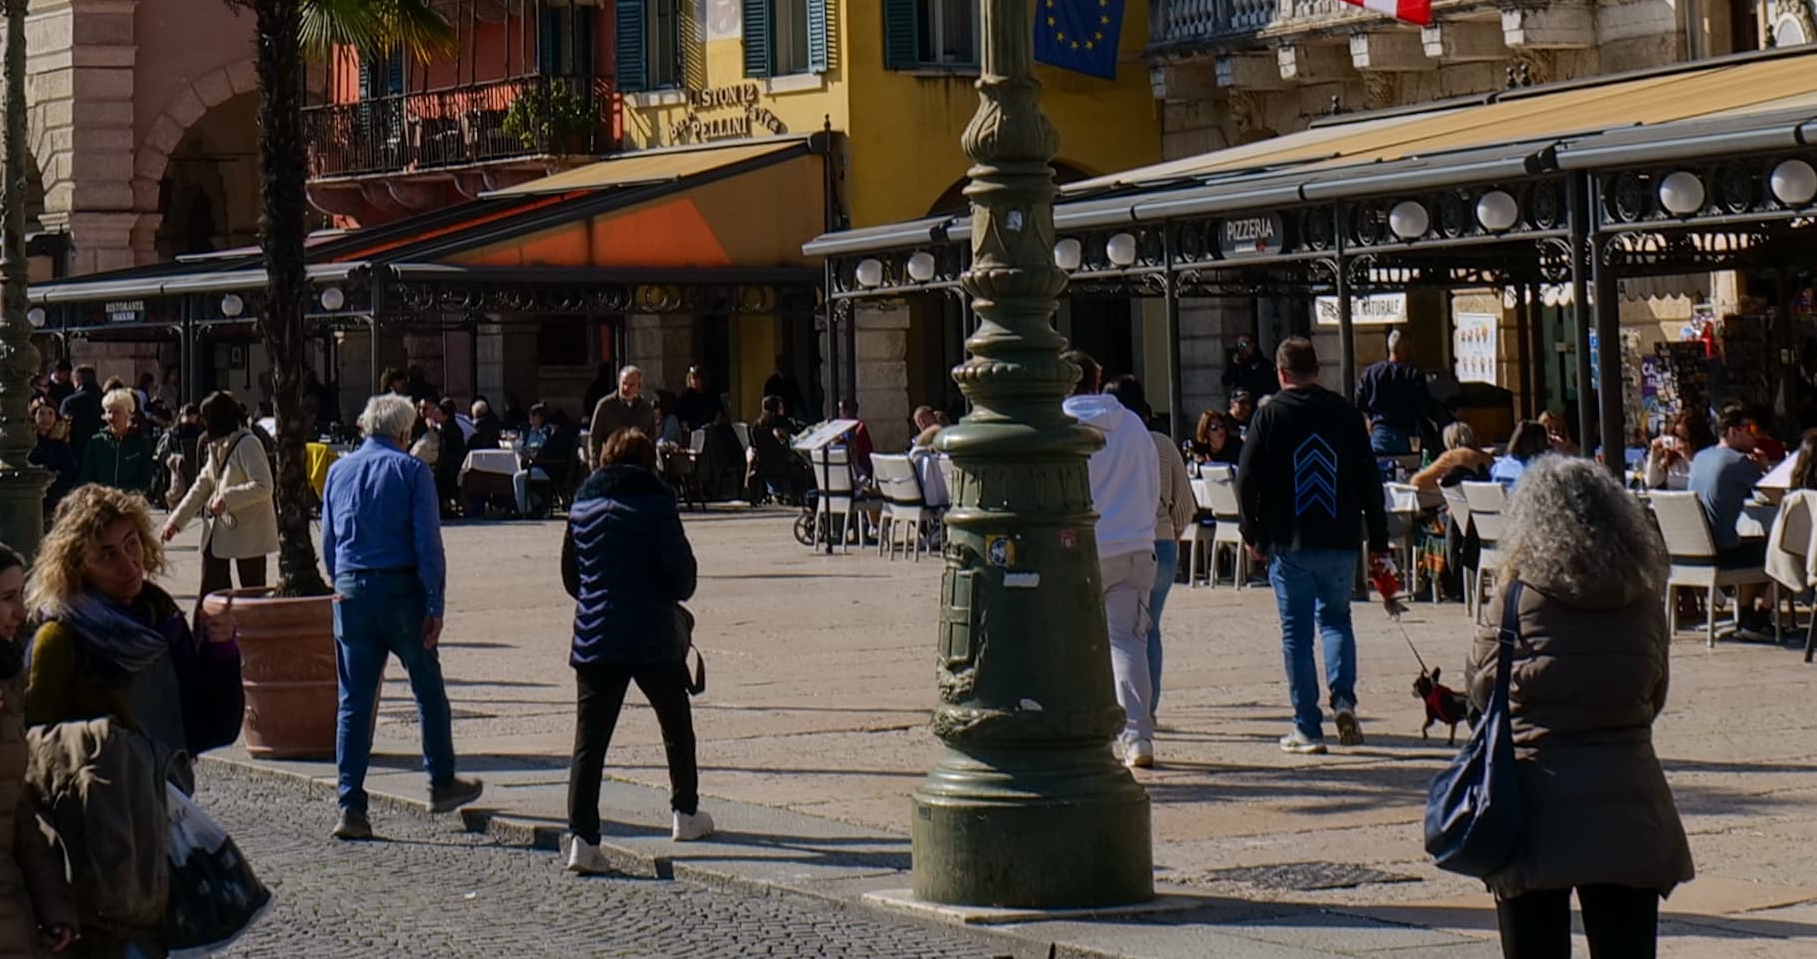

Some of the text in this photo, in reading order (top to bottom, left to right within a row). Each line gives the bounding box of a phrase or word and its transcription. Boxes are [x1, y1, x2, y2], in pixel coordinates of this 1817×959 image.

[741, 84, 755, 103] 12
[691, 114, 748, 139] PELLINI
[1227, 218, 1274, 241] PIZZERIA
